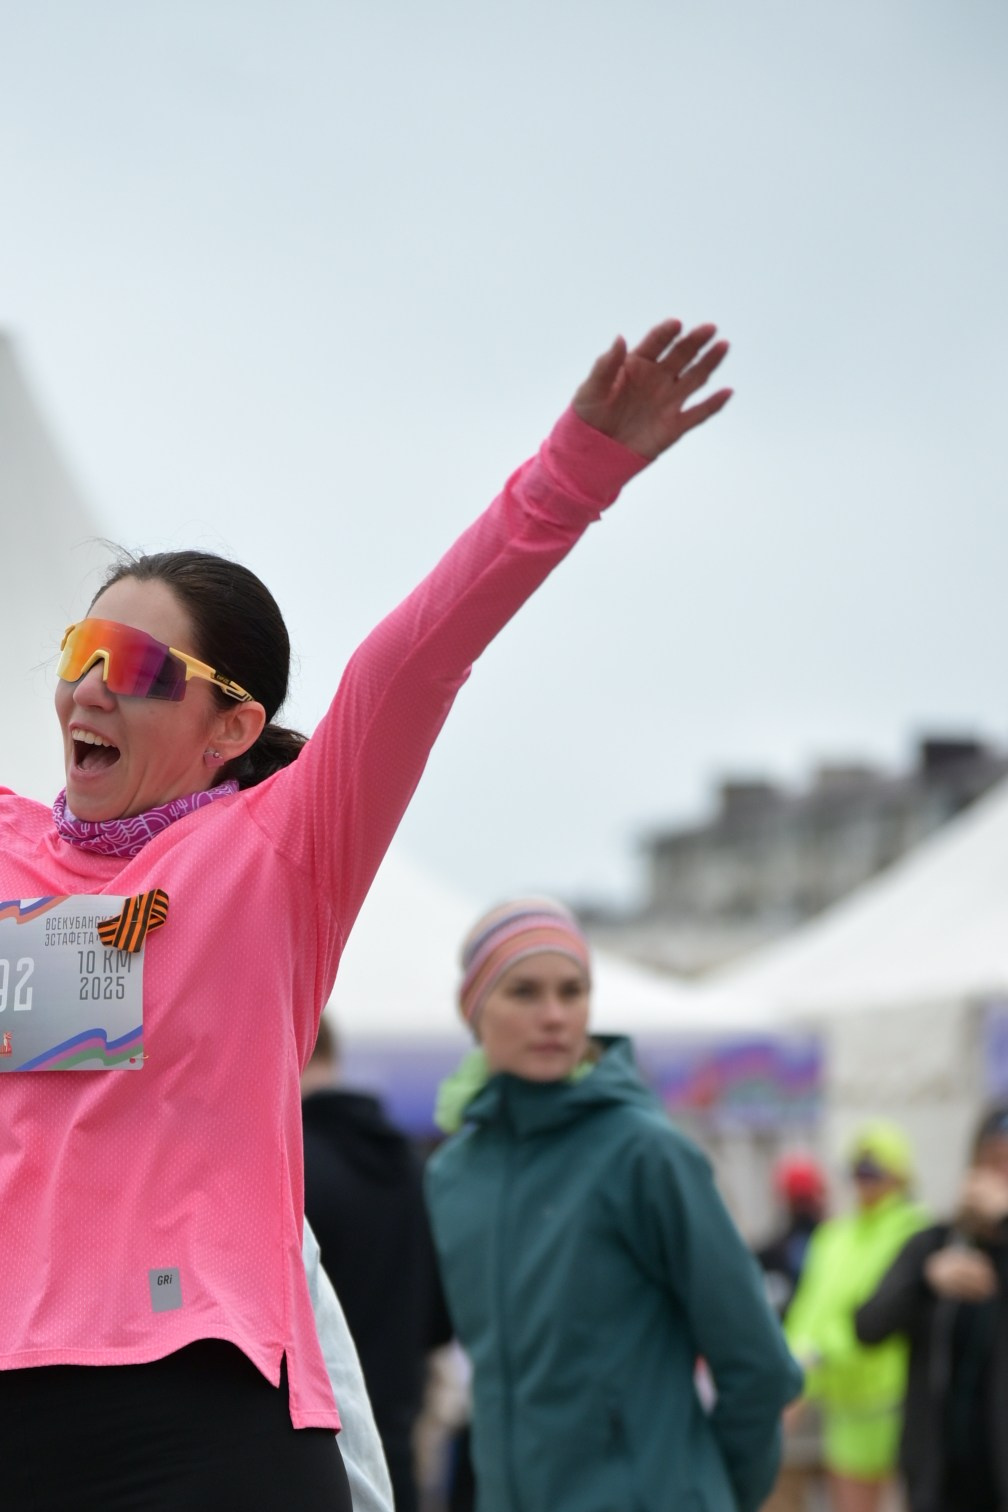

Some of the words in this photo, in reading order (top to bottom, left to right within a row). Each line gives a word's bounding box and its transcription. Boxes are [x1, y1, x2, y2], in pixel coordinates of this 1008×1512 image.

[44, 931, 95, 947] ЭСТАФЕТА
[77, 950, 96, 975] 10
[79, 975, 125, 1001] 2025
